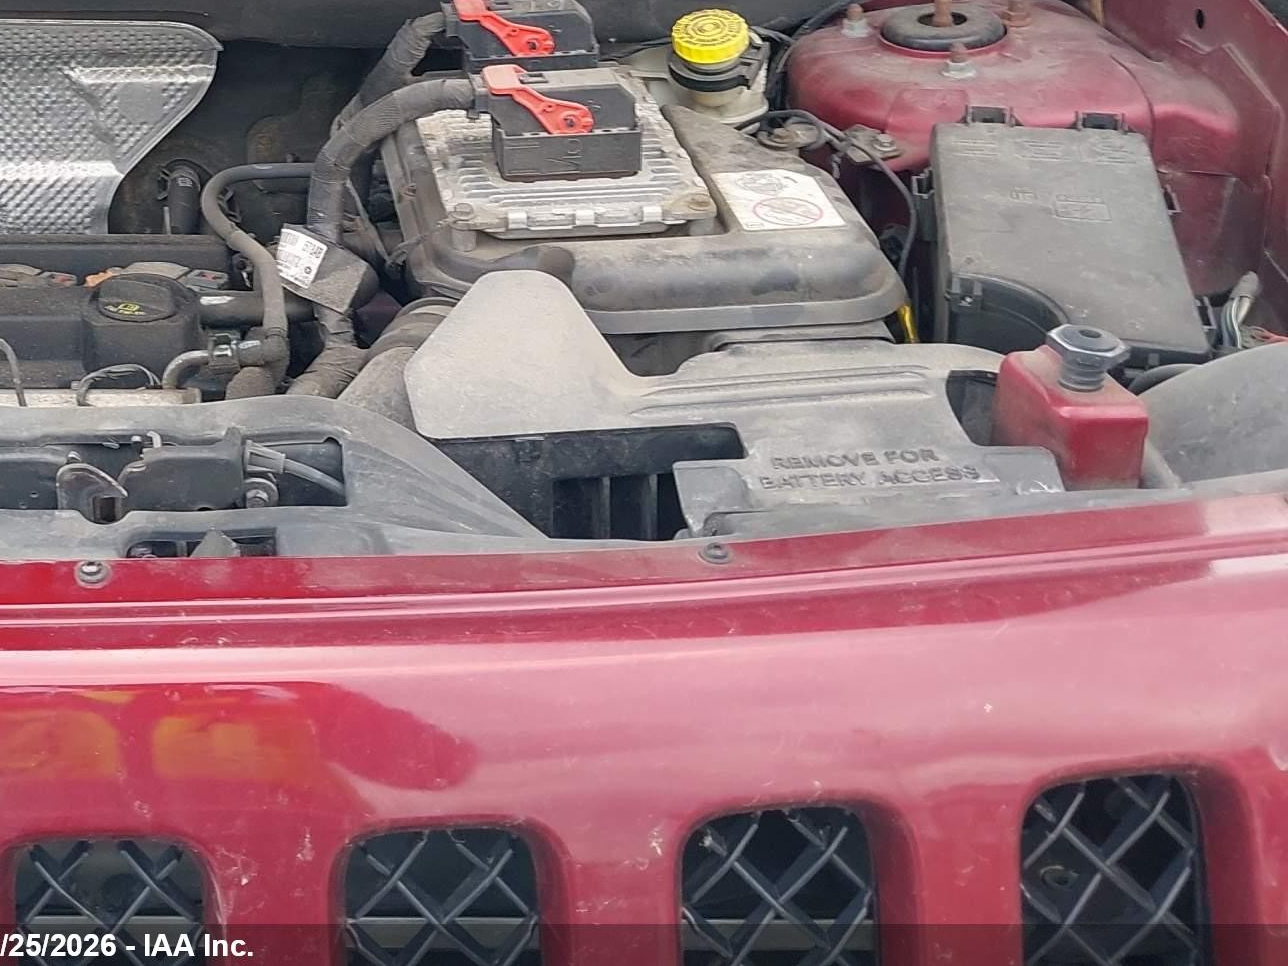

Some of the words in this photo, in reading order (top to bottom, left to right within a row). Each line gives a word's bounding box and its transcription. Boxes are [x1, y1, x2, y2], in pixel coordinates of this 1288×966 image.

[772, 451, 880, 469] REMOVE
[884, 449, 939, 464] FOR
[760, 472, 866, 489] BATTERY
[879, 465, 980, 484] ACCESS
